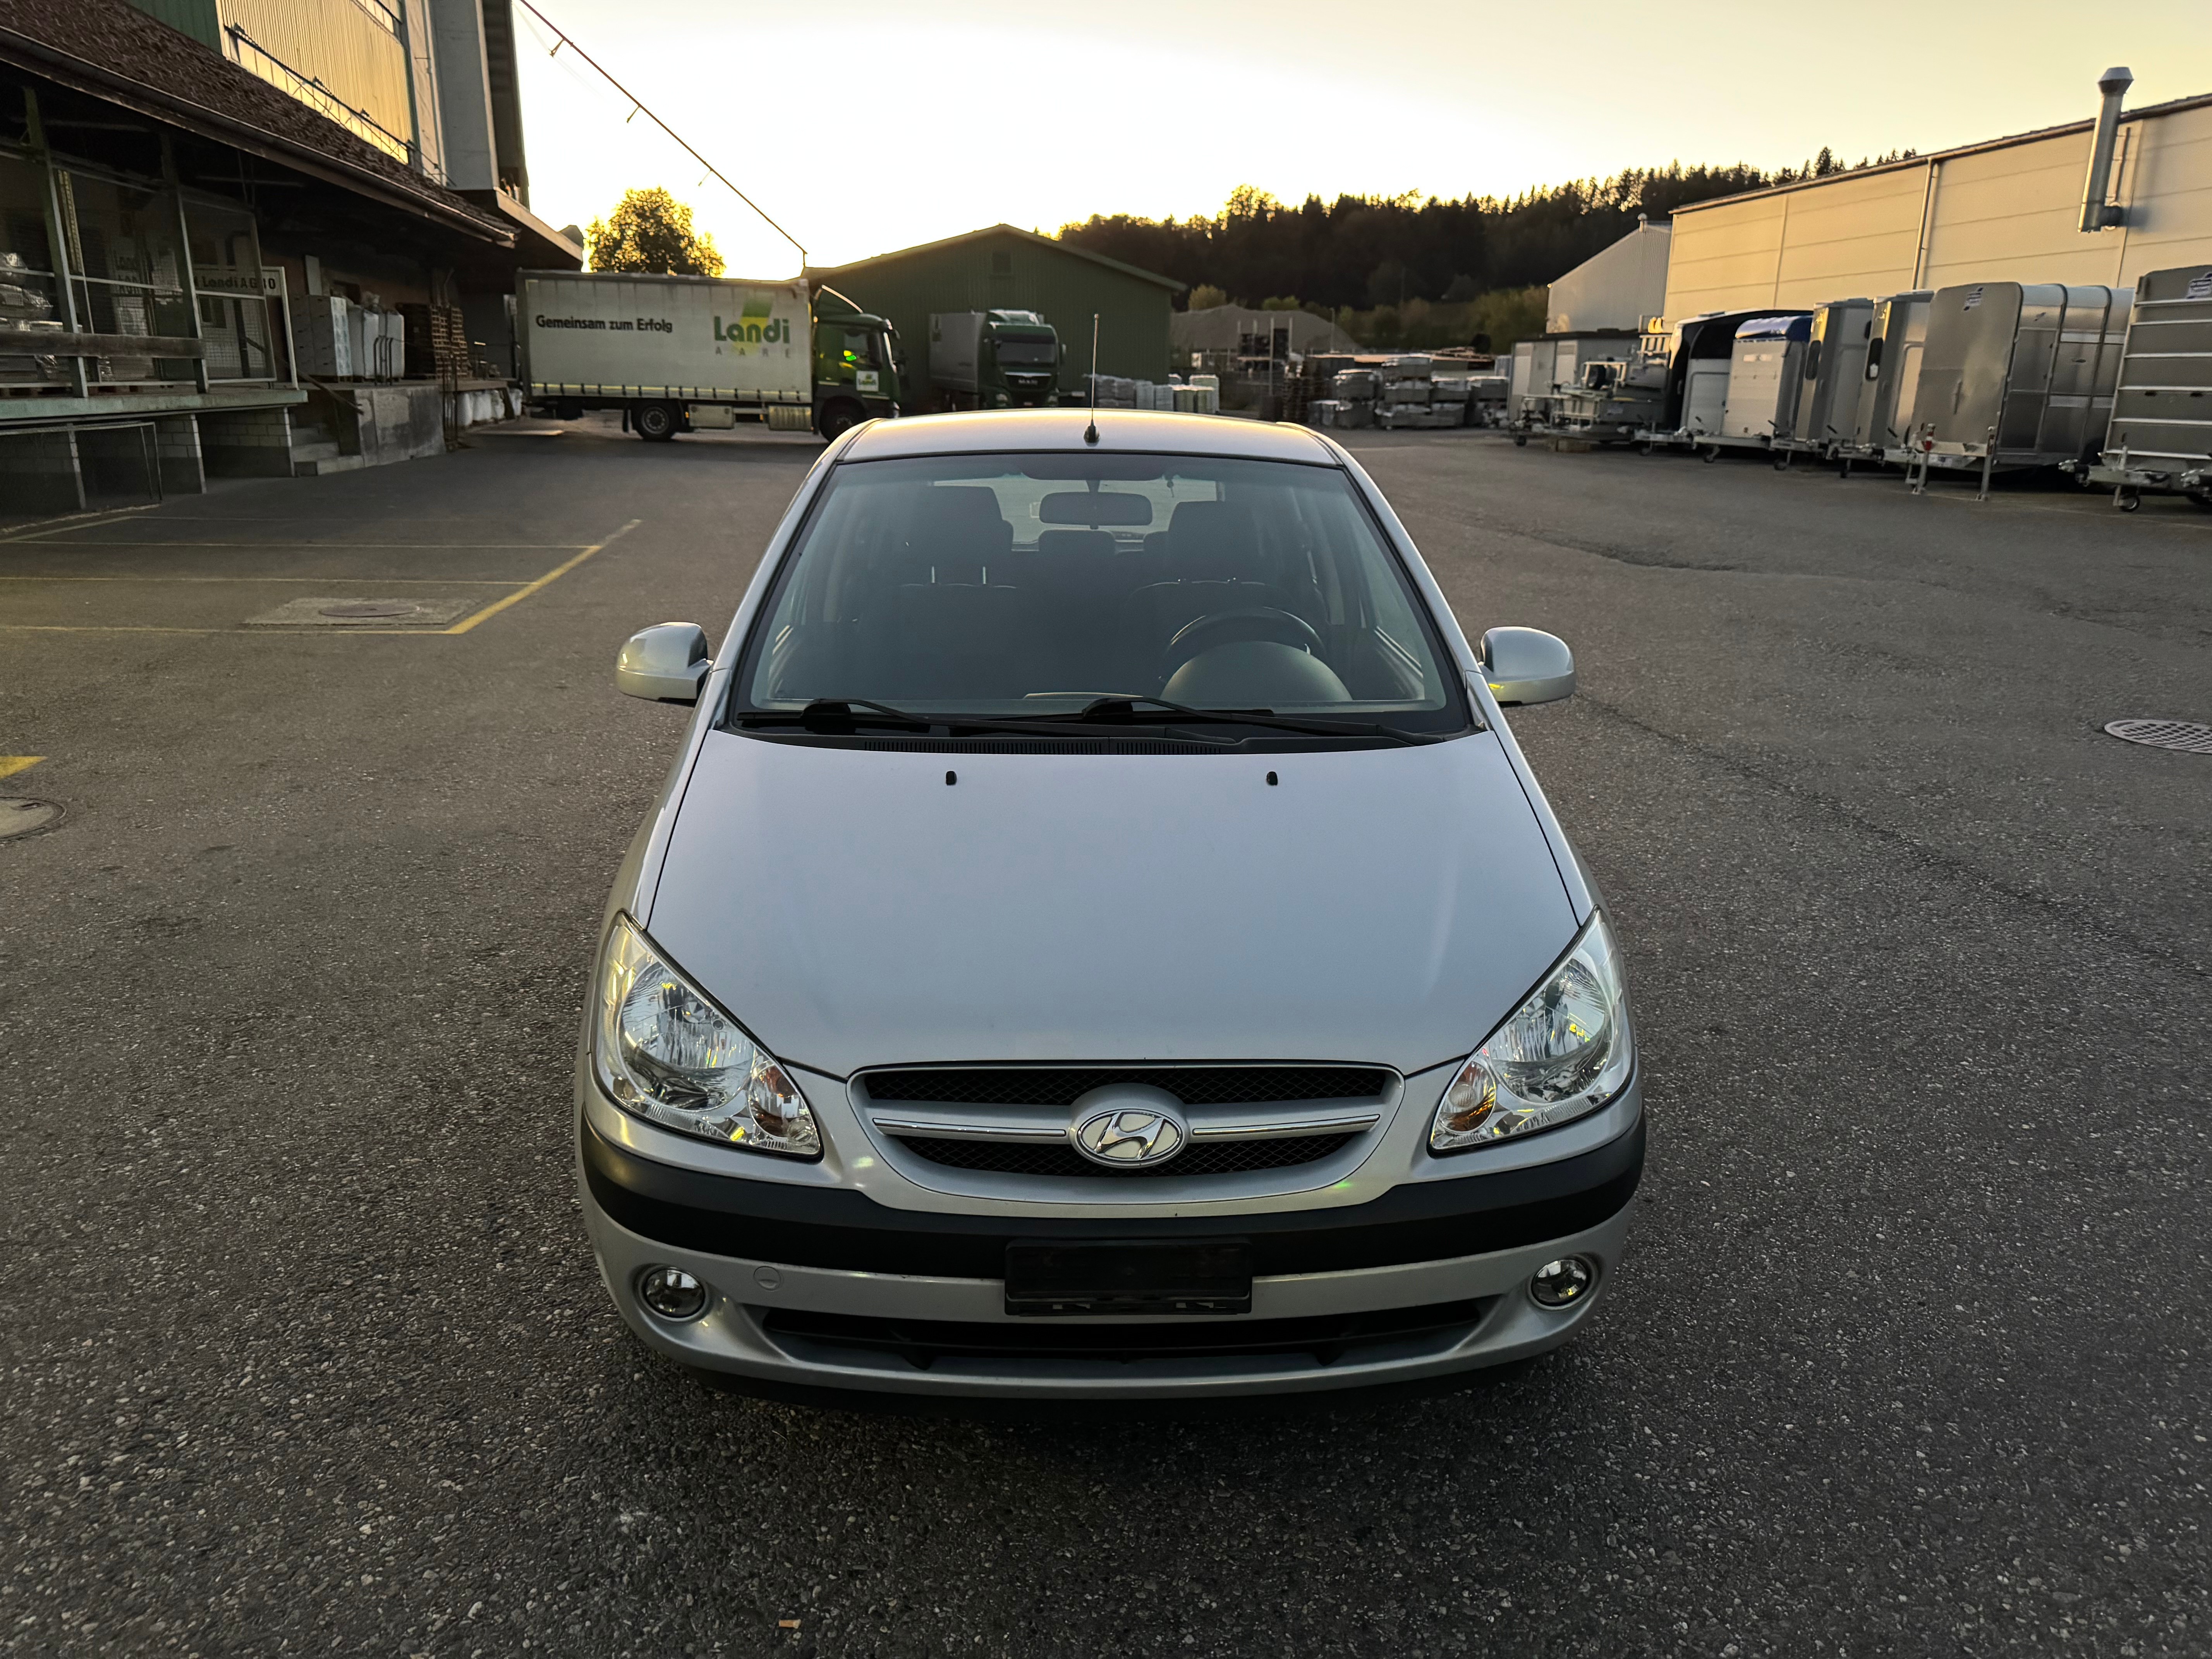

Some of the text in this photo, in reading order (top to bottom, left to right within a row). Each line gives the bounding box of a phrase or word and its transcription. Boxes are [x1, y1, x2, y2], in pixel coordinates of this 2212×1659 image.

[535, 314, 673, 333] Gemeinsam zum Erfolg
[714, 316, 790, 343] Landi
